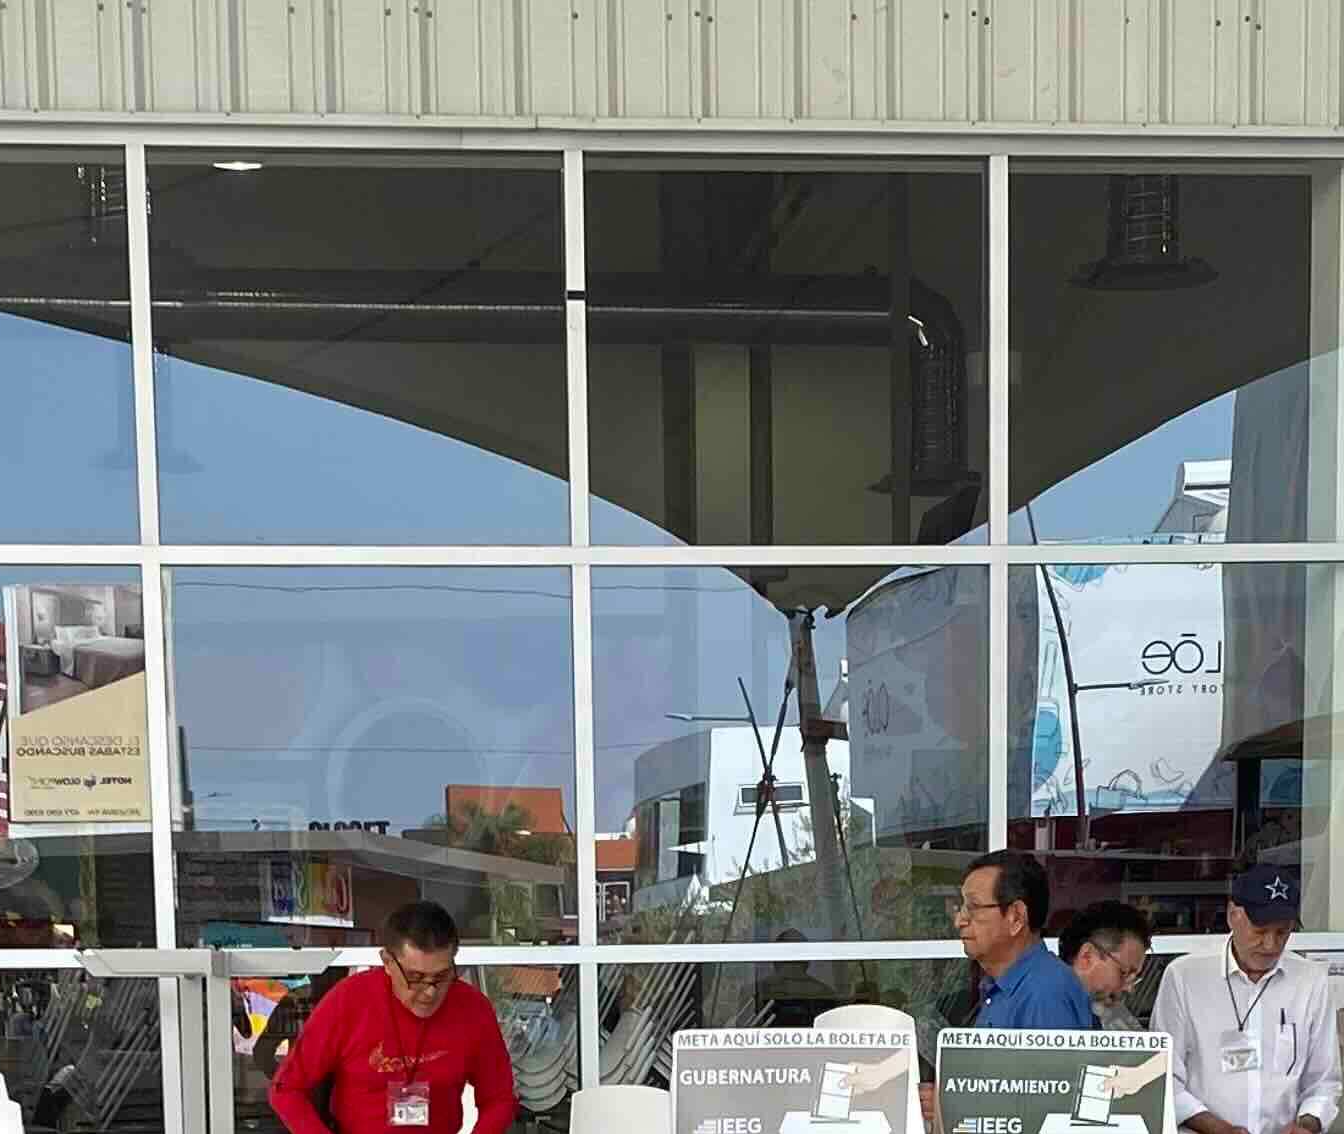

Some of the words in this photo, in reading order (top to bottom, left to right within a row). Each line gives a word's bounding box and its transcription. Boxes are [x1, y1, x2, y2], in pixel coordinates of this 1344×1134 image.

[677, 1034, 719, 1047] META
[763, 1033, 803, 1047] SOLO
[807, 1033, 826, 1047] LA
[829, 1033, 888, 1047] BOLETA
[890, 1034, 910, 1047] DE
[942, 1033, 980, 1047] META
[1027, 1034, 1067, 1047] SOLO
[1069, 1035, 1086, 1047] LA
[1090, 1035, 1145, 1048] BOLETA
[1148, 1035, 1169, 1049] DE
[680, 1068, 812, 1087] GUBERNATURA
[945, 1078, 1071, 1095] AYUNTAMIENTO
[718, 1118, 762, 1134] IEEG
[975, 1117, 1022, 1134] IEEG
